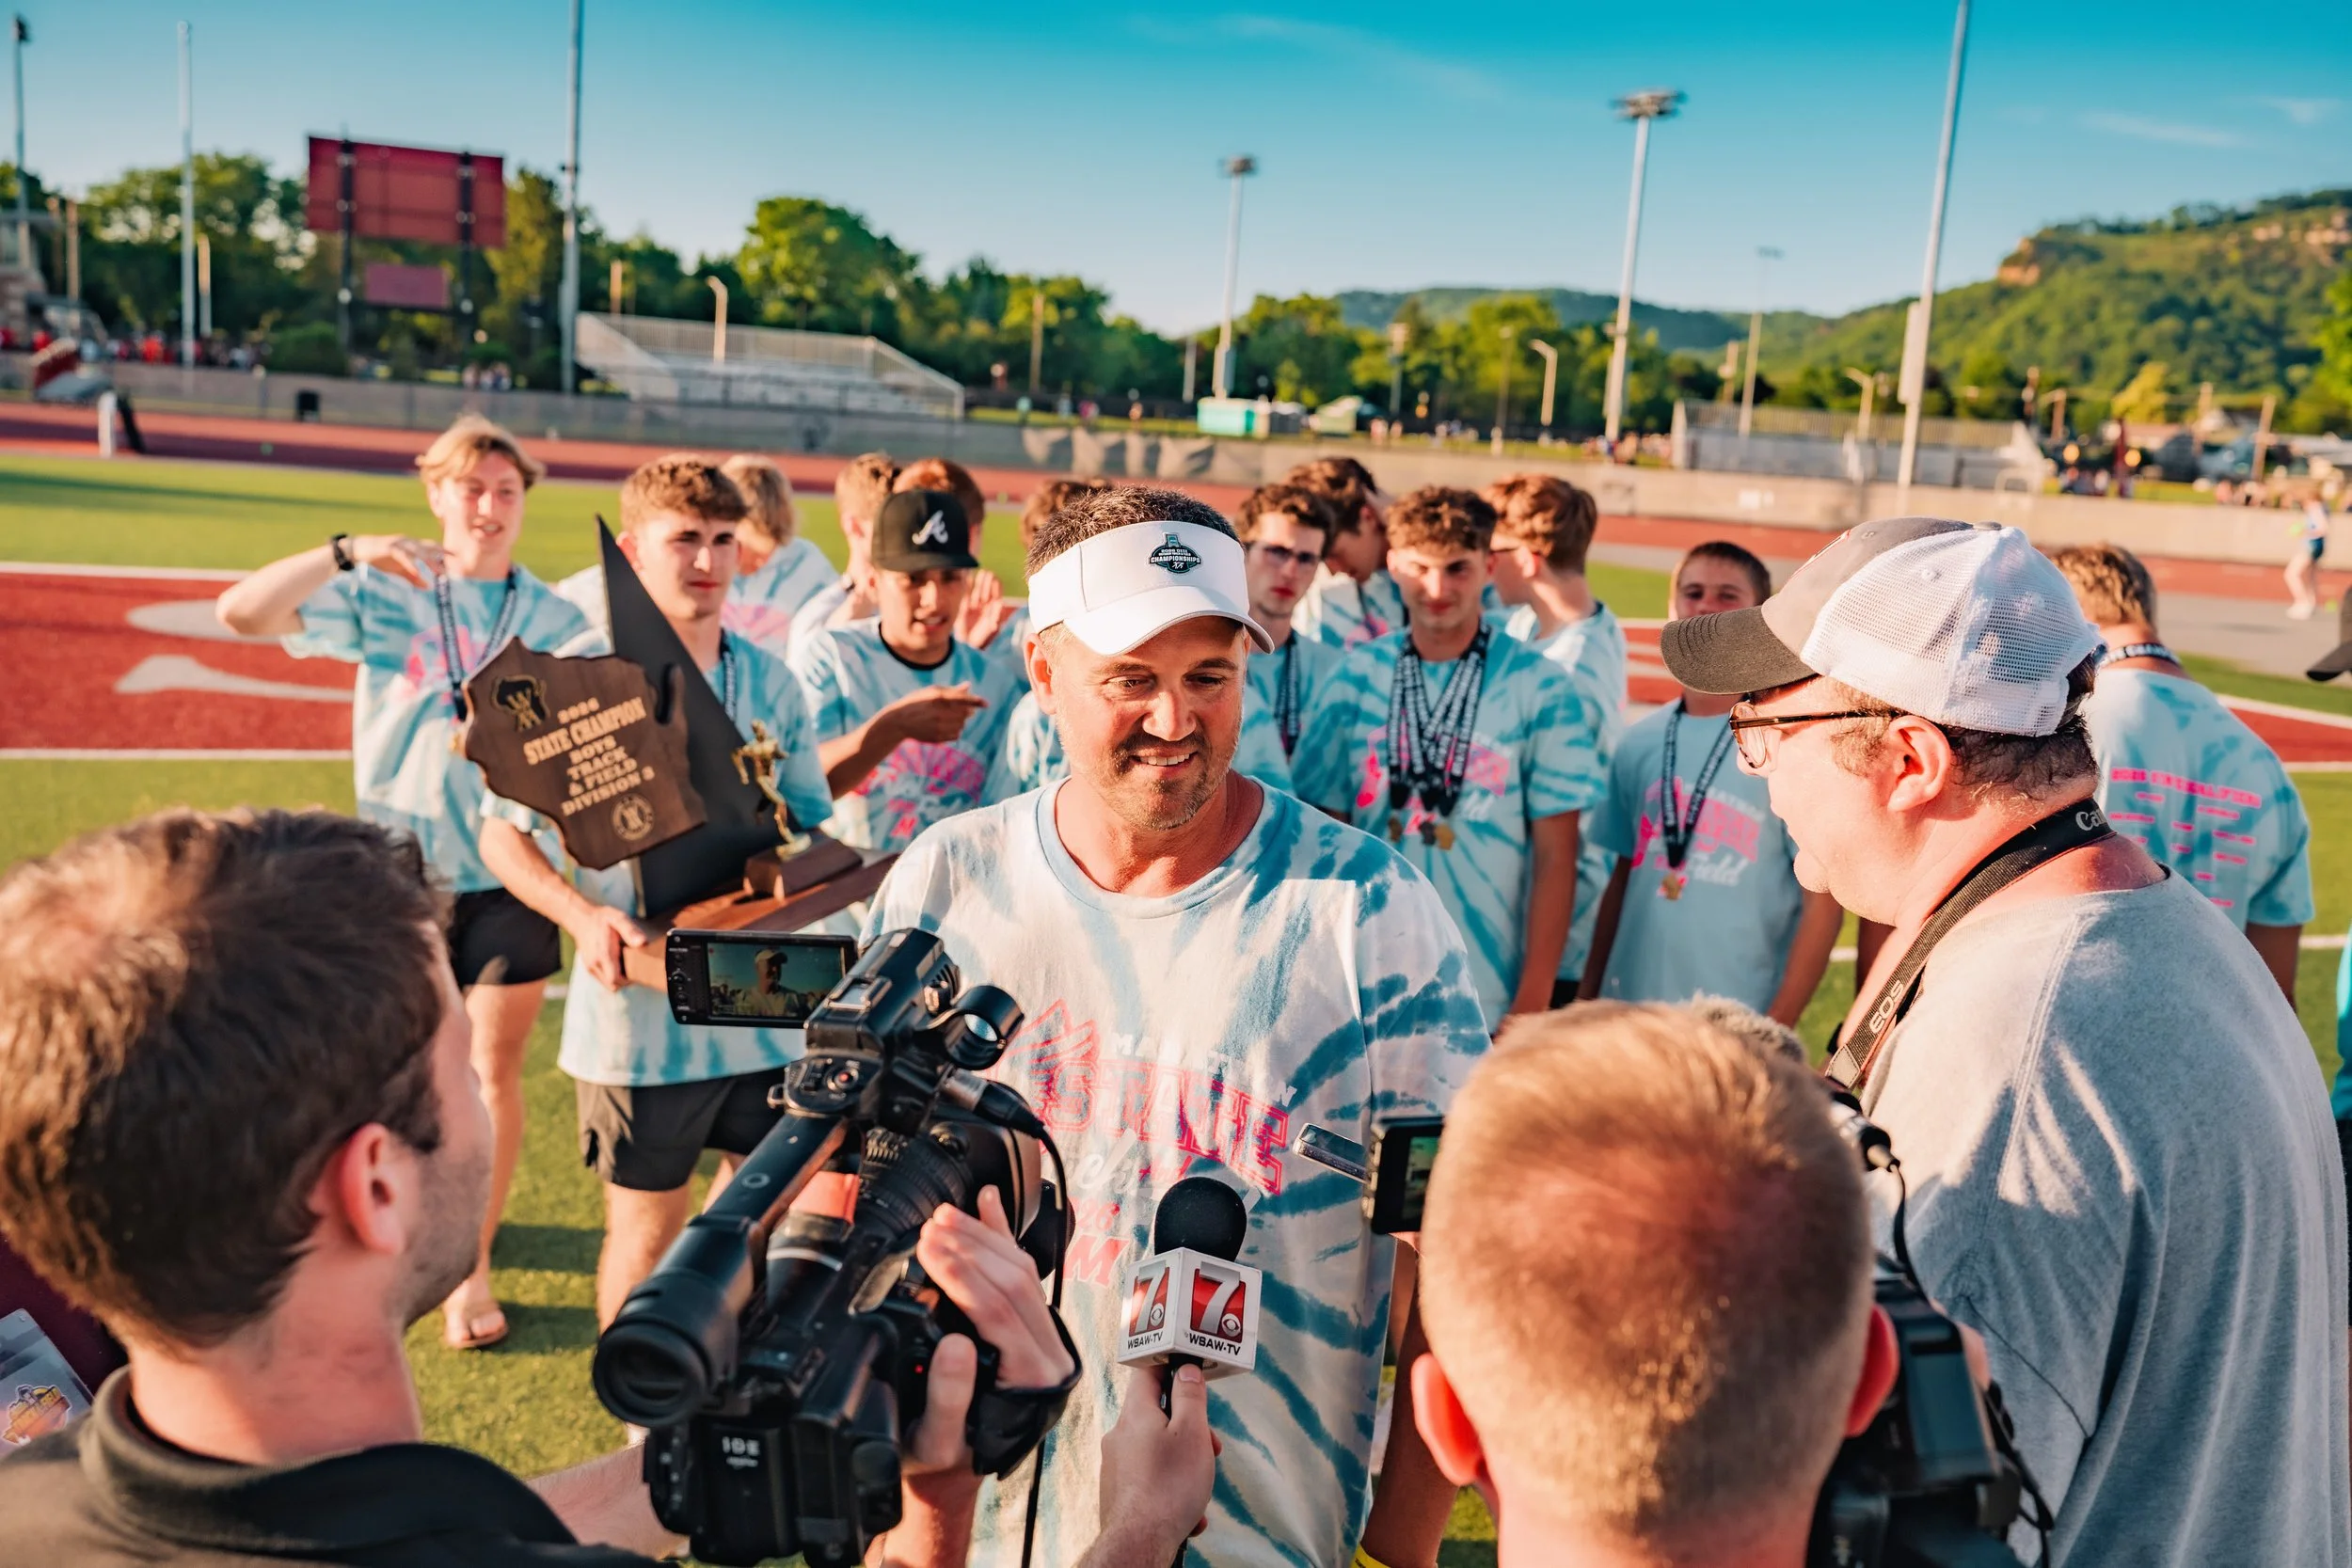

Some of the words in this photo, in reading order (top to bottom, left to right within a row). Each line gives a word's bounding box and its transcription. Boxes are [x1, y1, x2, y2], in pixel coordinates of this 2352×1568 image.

[912, 510, 948, 545] A
[1151, 555, 1200, 563] CHAMPIONSHIPS
[523, 727, 573, 766] STATE
[570, 696, 646, 745] CHAMPION
[569, 735, 616, 764] BOYS
[566, 746, 628, 780] TRACK
[569, 782, 584, 797] &
[583, 757, 637, 789] FIELD
[562, 771, 642, 816] DIVISION
[1868, 979, 1904, 1034] EOS
[1045, 1059, 1289, 1196] STATE
[1063, 1234, 1130, 1286] M
[1135, 1260, 1166, 1334] 7
[1199, 1261, 1241, 1334] 7
